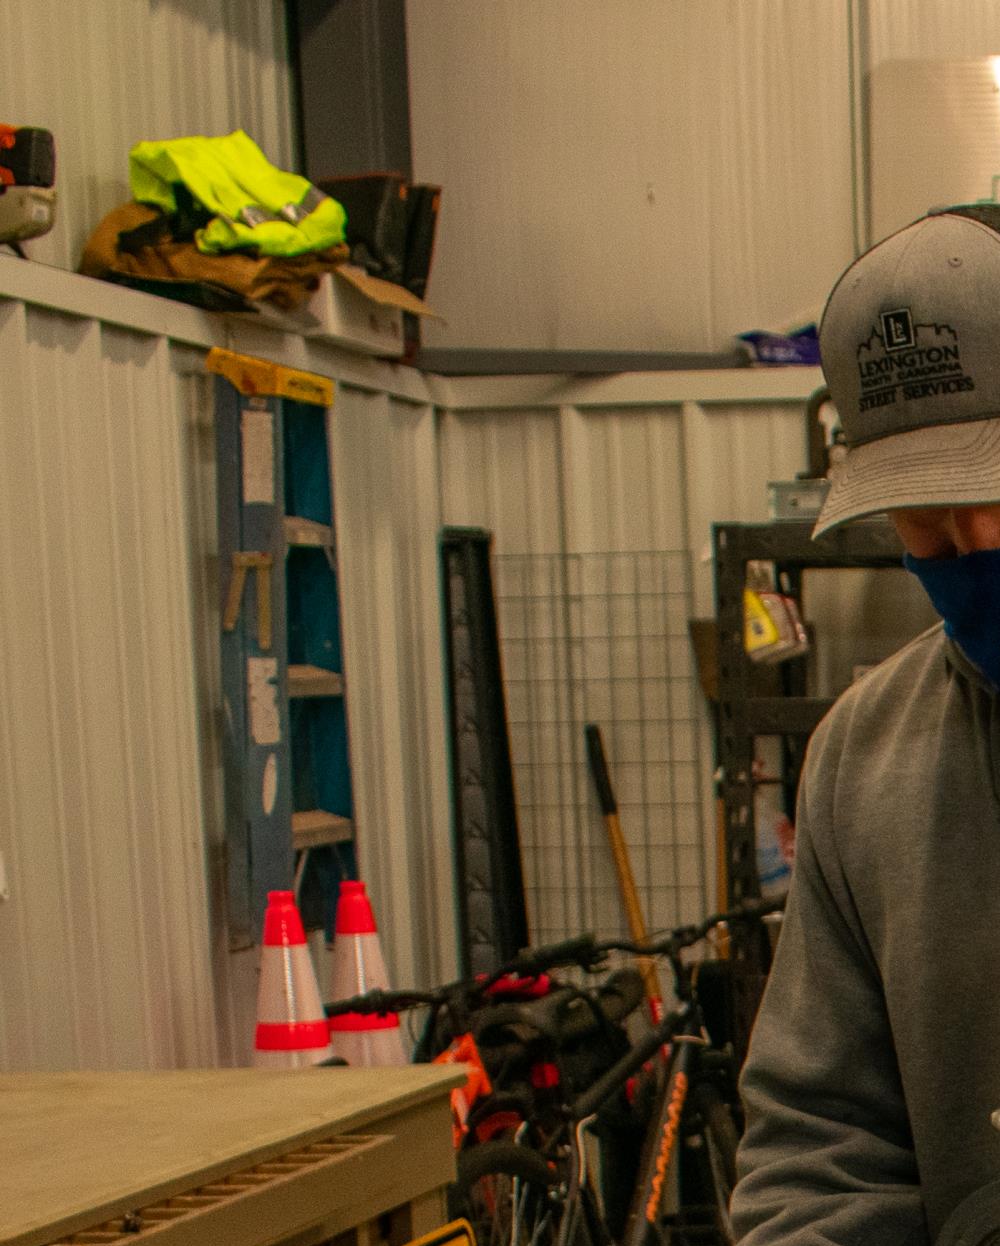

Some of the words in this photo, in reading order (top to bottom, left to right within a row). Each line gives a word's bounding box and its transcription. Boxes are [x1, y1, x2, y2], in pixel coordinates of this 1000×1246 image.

[858, 345, 959, 379] LEXINGTON
[859, 390, 897, 412] STREET
[903, 376, 975, 401] SERVICES
